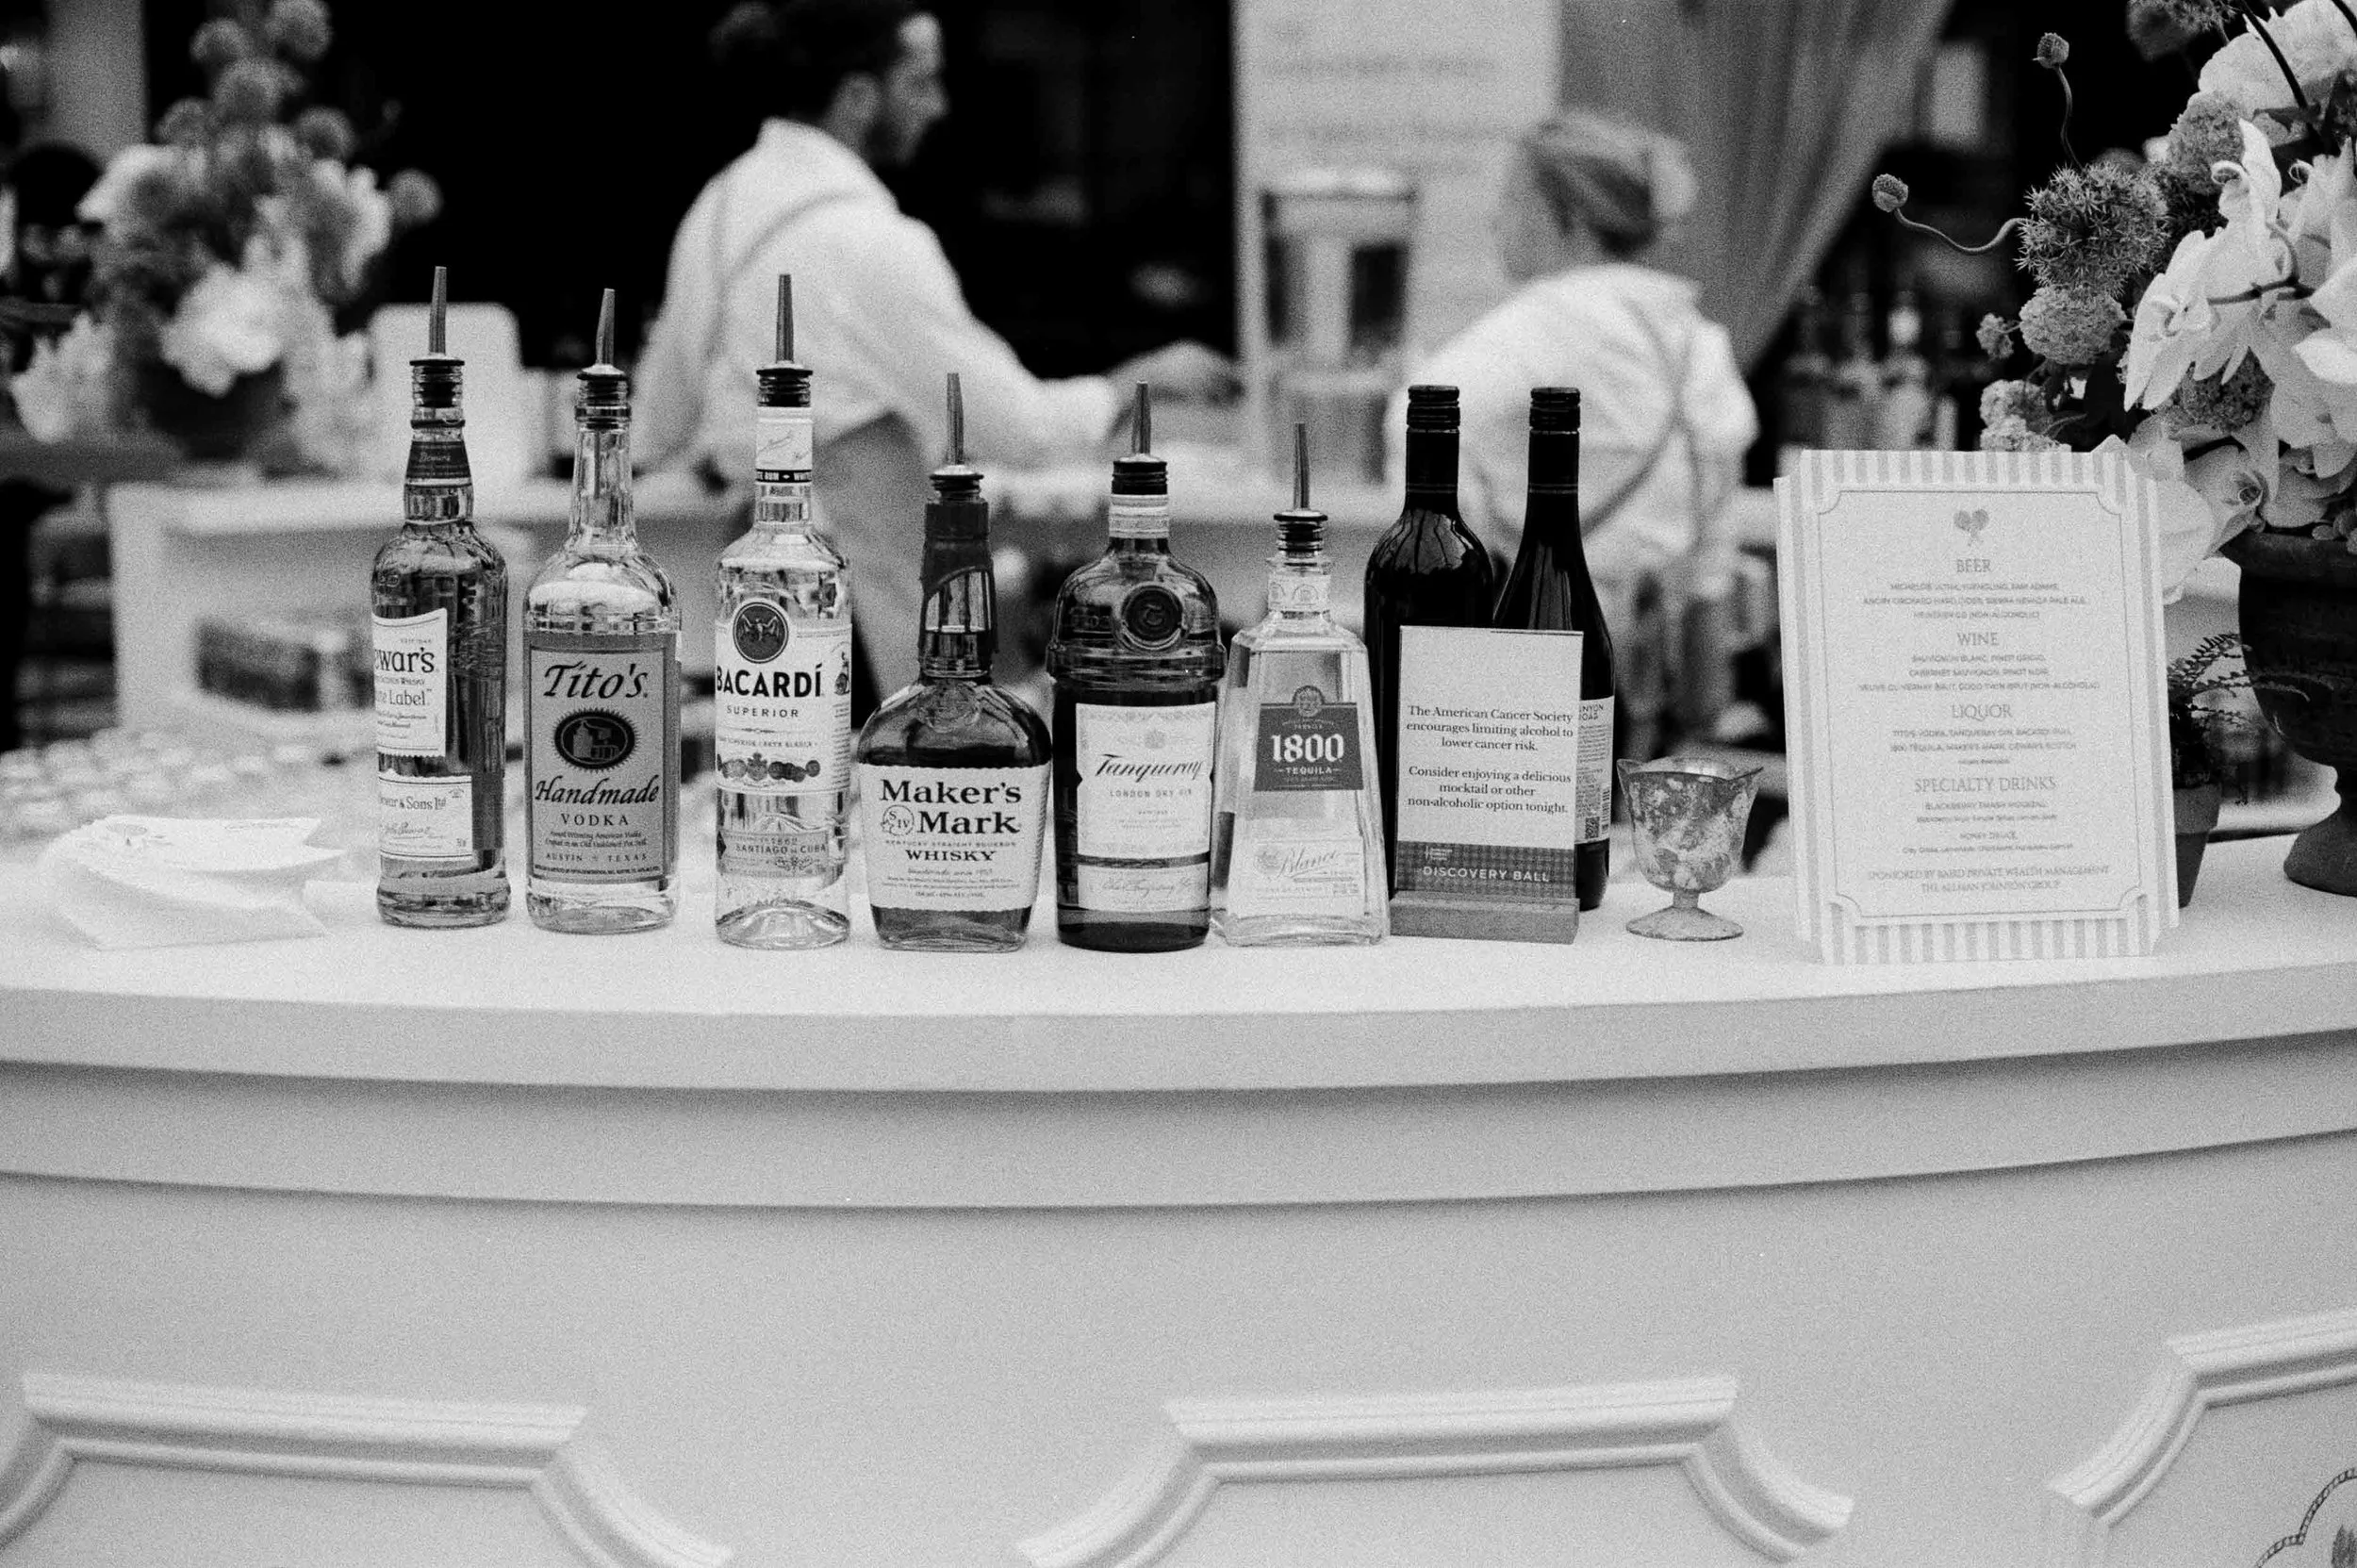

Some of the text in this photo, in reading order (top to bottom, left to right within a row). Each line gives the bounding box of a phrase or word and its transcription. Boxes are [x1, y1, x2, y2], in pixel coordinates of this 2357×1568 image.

[1956, 558, 1991, 573] BEER
[1956, 632, 2001, 647] WINE
[543, 661, 649, 699] Tito's
[717, 662, 822, 698] BACARDÍ
[388, 689, 426, 706] Label
[726, 705, 799, 718] SUPERIOR
[1409, 705, 1574, 723] The American Cancer Society
[1951, 704, 2014, 721] LIQUOR
[1406, 722, 1574, 737] encourages limiting alcohol to
[1271, 734, 1344, 763] 1800
[1442, 736, 1539, 751] lower cancer risk.
[1095, 753, 1203, 783] Tanqueray
[1286, 767, 1333, 775] TEQUILA
[1409, 766, 1460, 778] Consider
[1461, 769, 1511, 783] enjoying
[1522, 770, 1572, 784] delicious
[535, 774, 660, 804] Handmade
[879, 779, 1021, 803] Maker's
[1439, 783, 1537, 797] mocktail or other
[1914, 776, 2057, 793] SPECIALTY DRINKS
[1110, 789, 1151, 799] LONDON
[405, 796, 434, 810] Sons
[1408, 797, 1569, 815] non-alcoholic option tonight.
[560, 812, 630, 826] VODKA
[917, 811, 1020, 834] Mark
[545, 852, 646, 862] AUSTIN TEXAS
[735, 844, 788, 854] SANTIAGO
[799, 843, 826, 854] CUBA
[905, 850, 997, 862] WHISKY
[1423, 866, 1551, 883] DISCOVERY BALL
